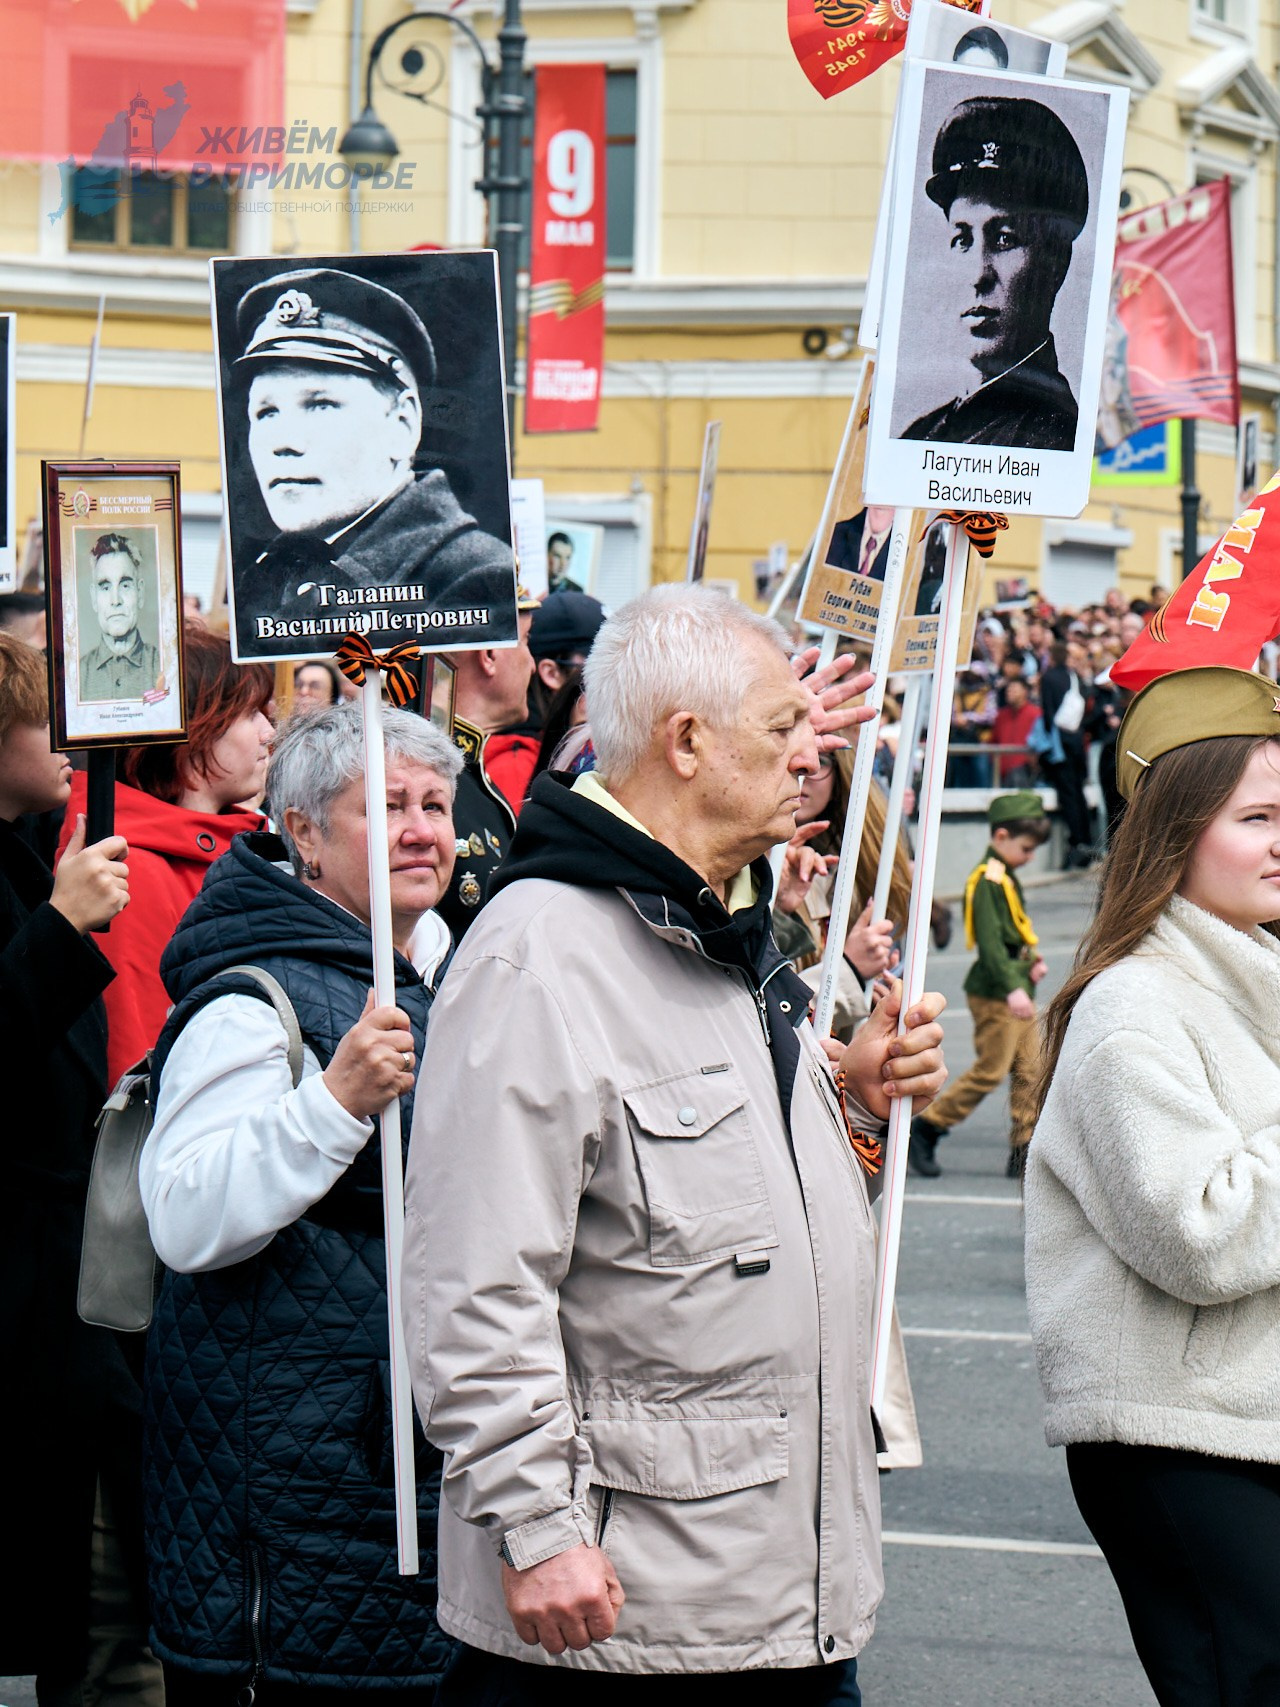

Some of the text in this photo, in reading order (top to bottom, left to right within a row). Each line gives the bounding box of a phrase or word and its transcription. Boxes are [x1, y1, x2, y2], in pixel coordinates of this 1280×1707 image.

[547, 129, 595, 218] 9
[922, 449, 1040, 477] Лагутин Иван
[99, 495, 152, 506] БЕССМЕРТНЫЙ
[928, 479, 1032, 506] Васильевич
[102, 504, 151, 515] ПОЛК РОССИИ
[318, 583, 425, 607] Галанин
[823, 590, 853, 609] Георгий
[849, 578, 873, 597] Рубан
[256, 607, 489, 639] Василий Петрович
